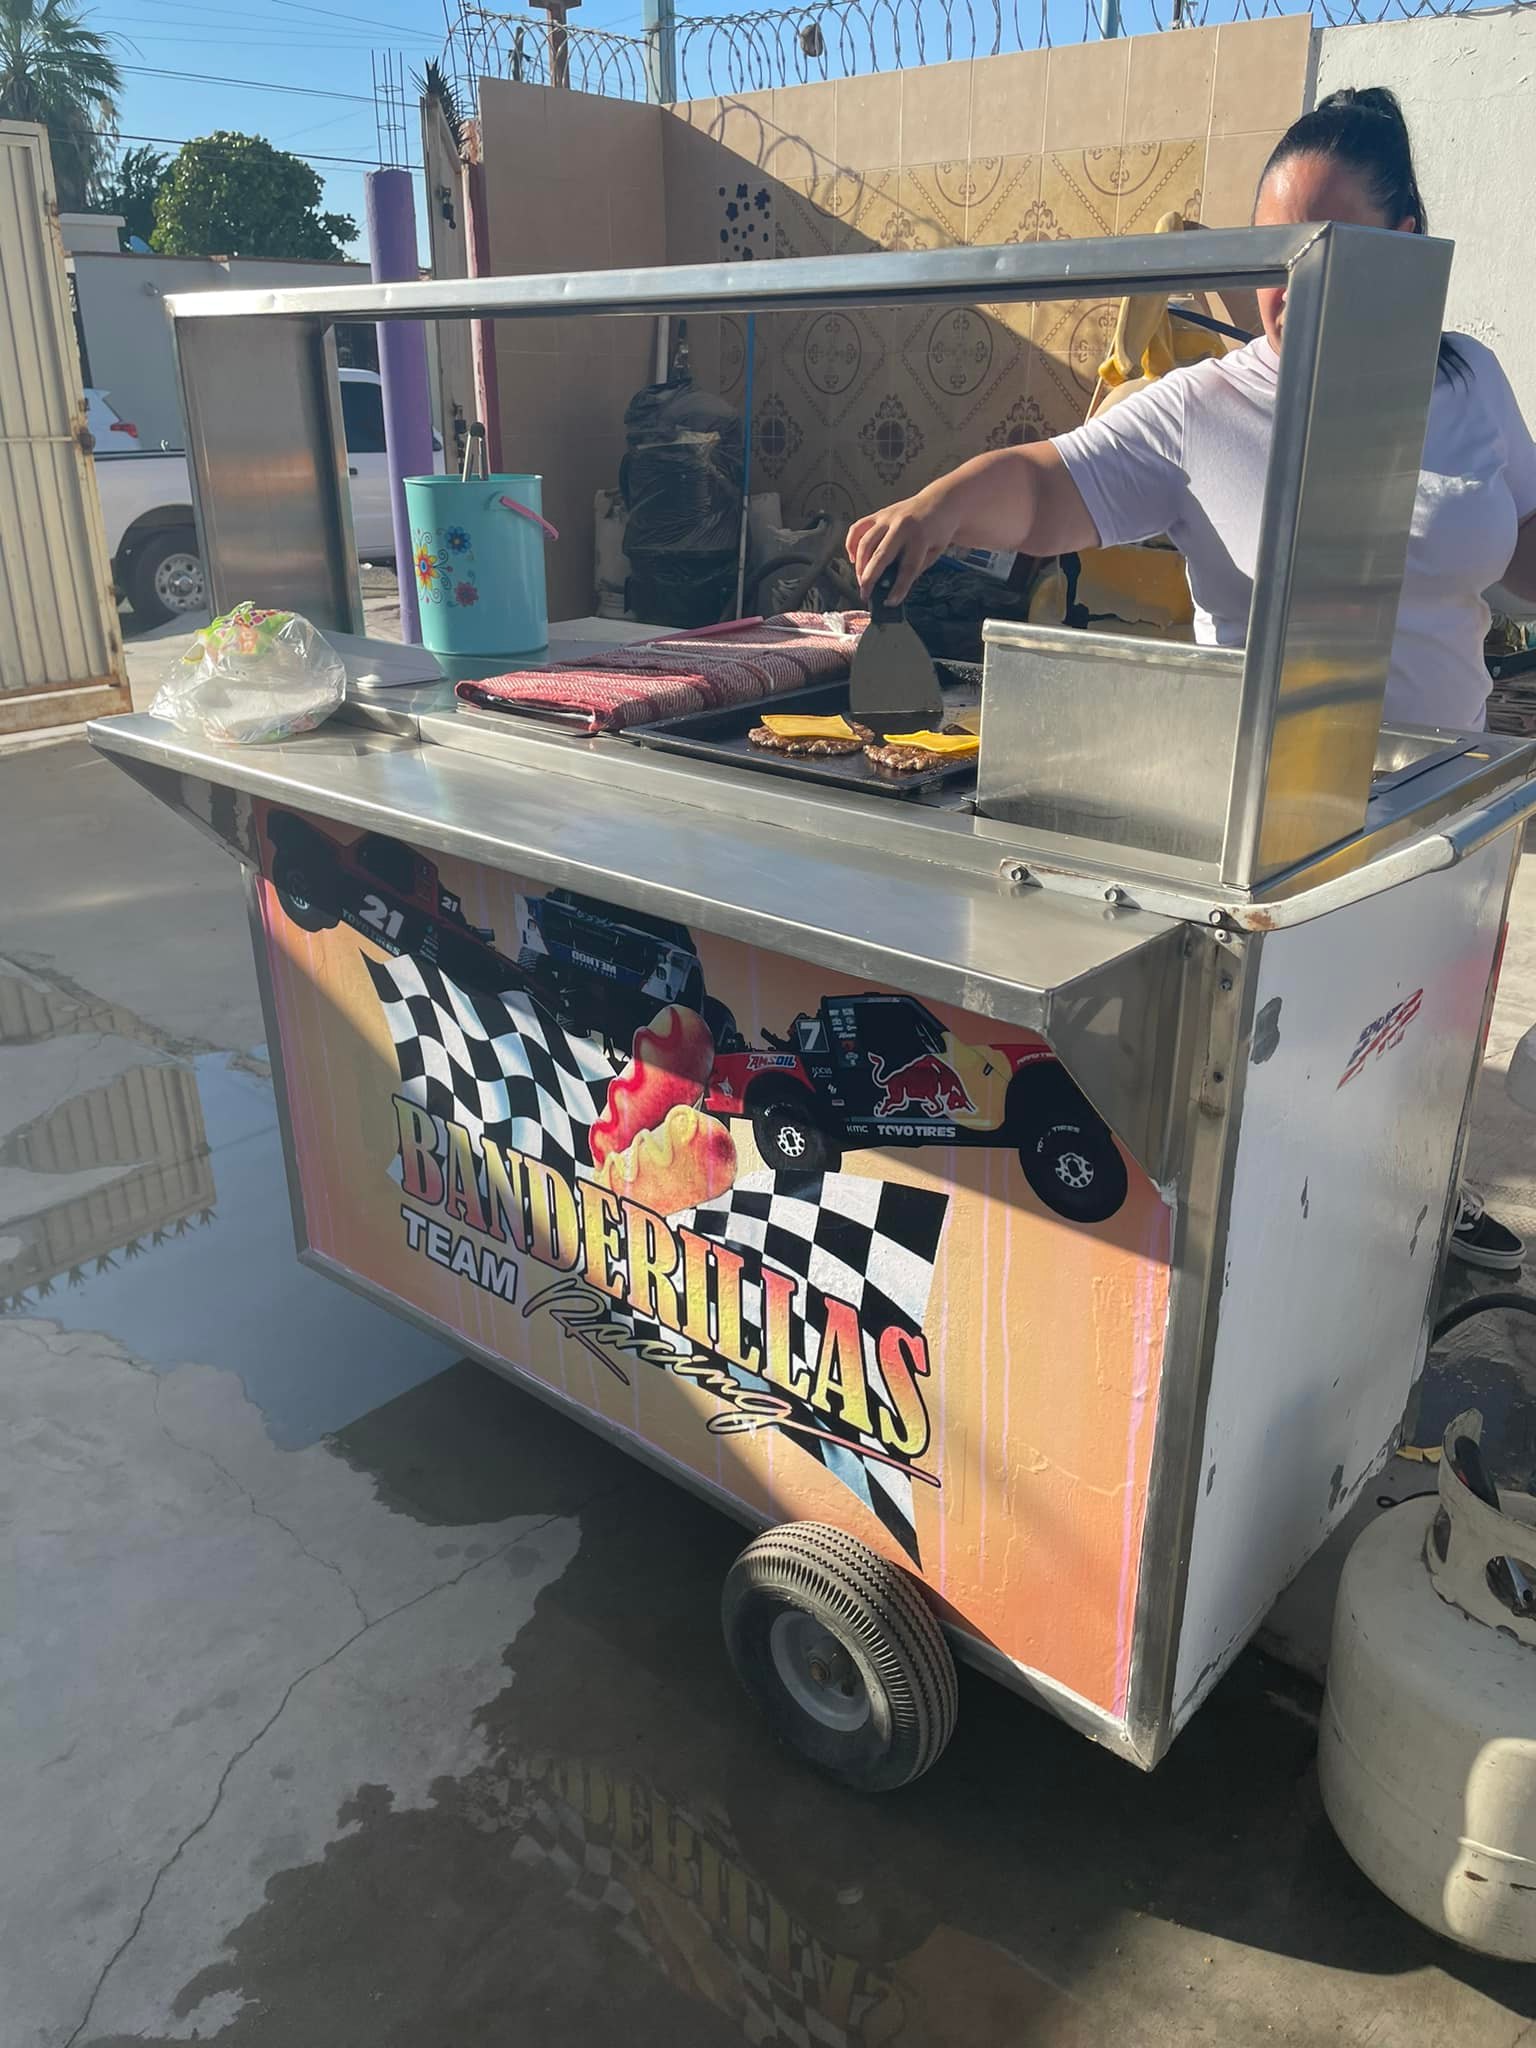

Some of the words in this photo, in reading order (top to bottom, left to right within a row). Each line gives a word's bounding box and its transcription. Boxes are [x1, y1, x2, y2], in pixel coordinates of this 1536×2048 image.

[359, 894, 405, 939] 21
[800, 1021, 821, 1050] 7
[747, 1054, 797, 1071] AMSOIL
[877, 1125, 914, 1136] TOYO
[915, 1126, 956, 1138] TIRES
[392, 1093, 931, 1459] BANDERILLAS
[401, 1206, 517, 1304] TEAM
[521, 1277, 942, 1489] Racing
